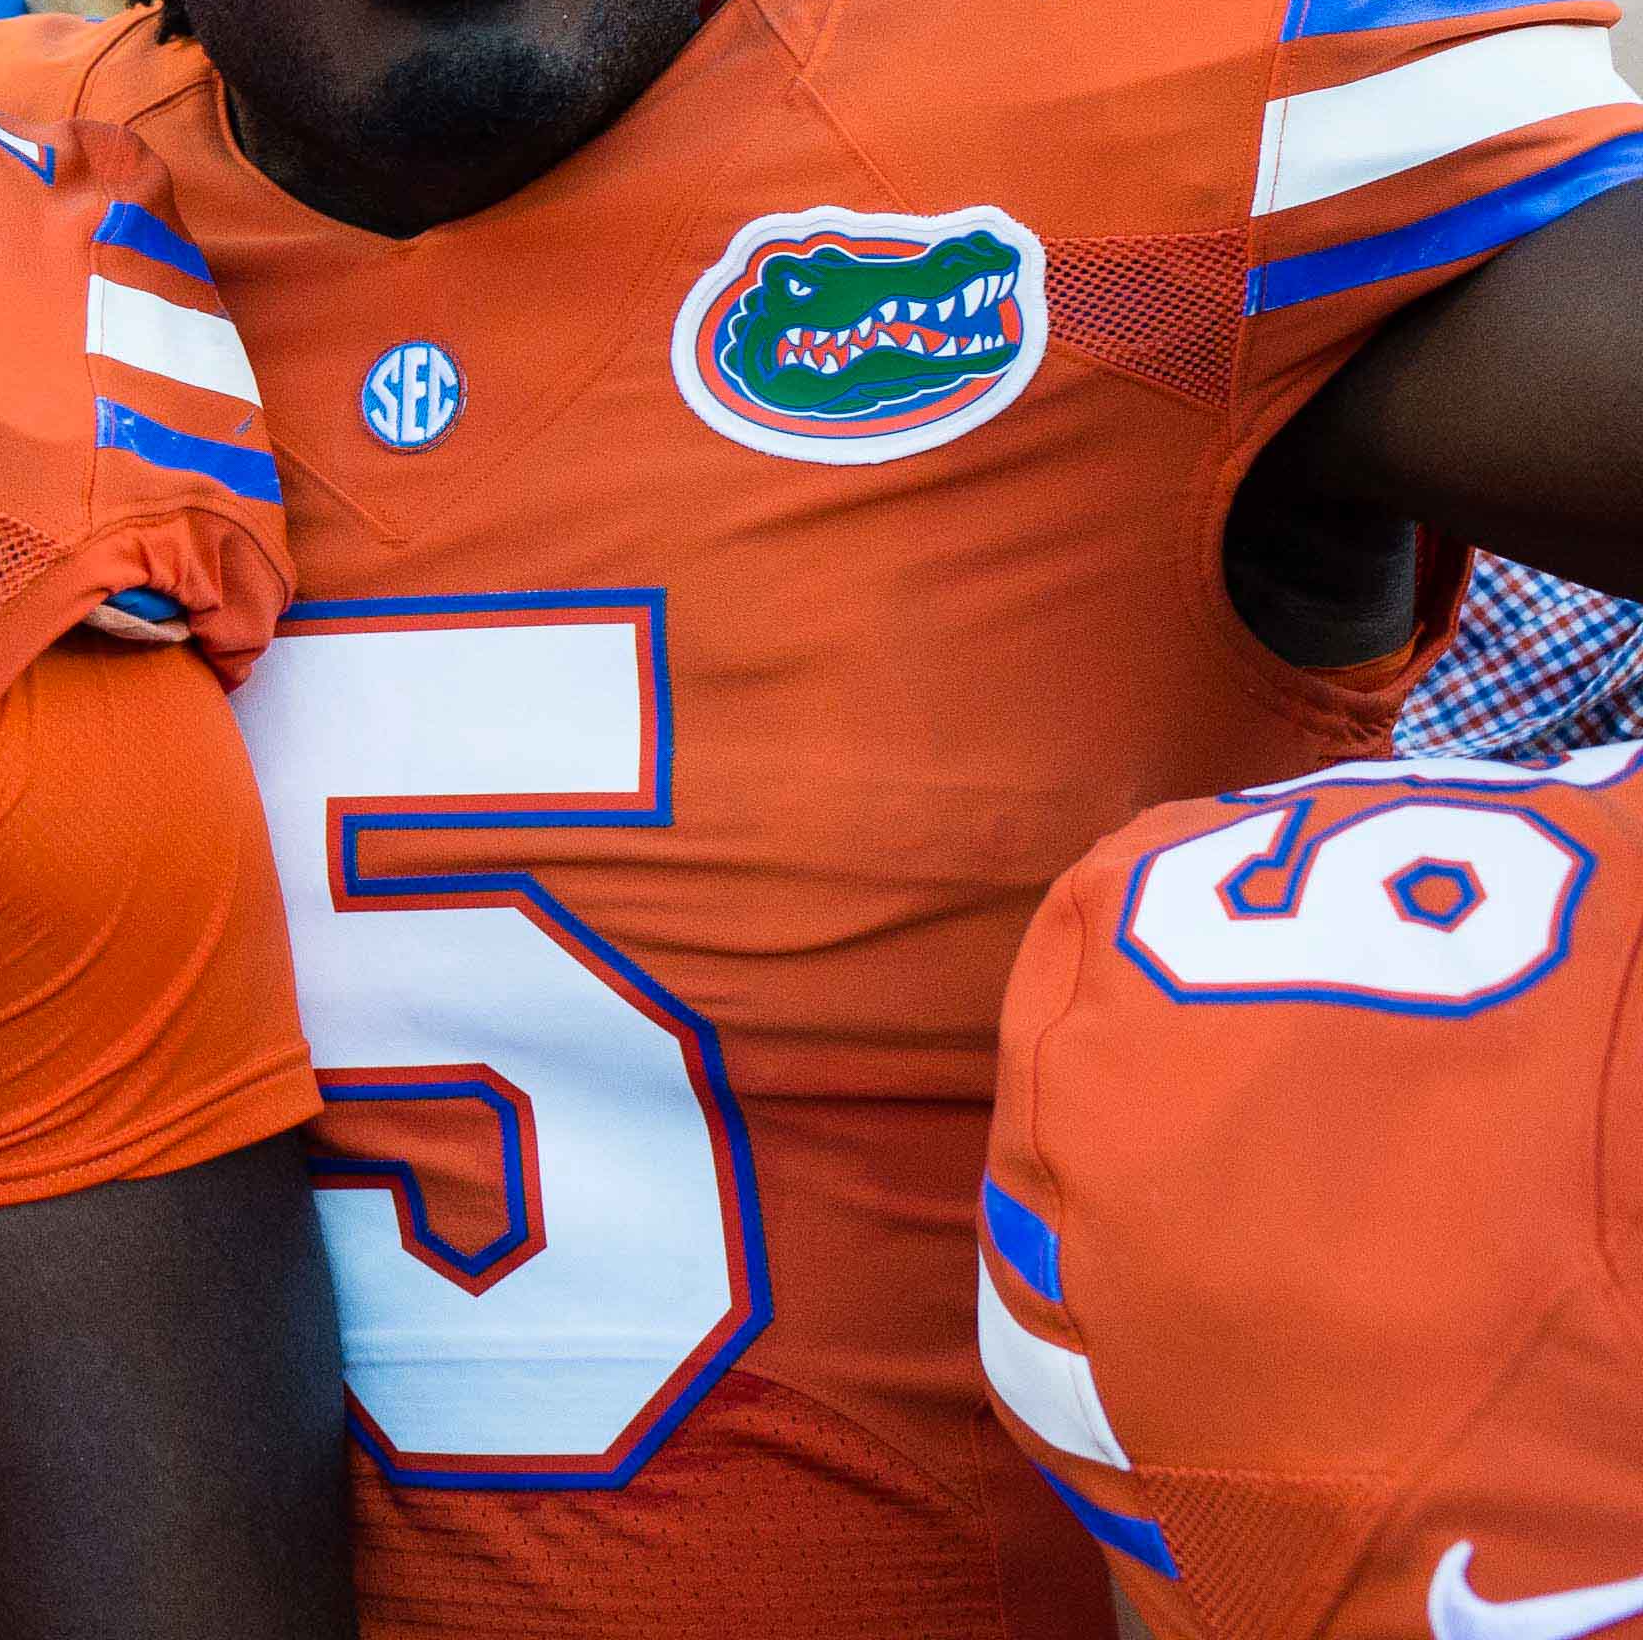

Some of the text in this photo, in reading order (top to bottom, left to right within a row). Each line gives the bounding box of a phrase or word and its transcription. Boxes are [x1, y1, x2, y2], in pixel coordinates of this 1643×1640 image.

[367, 344, 461, 444] SEC
[1114, 745, 1620, 1020] 9
[230, 587, 774, 1491] 5
